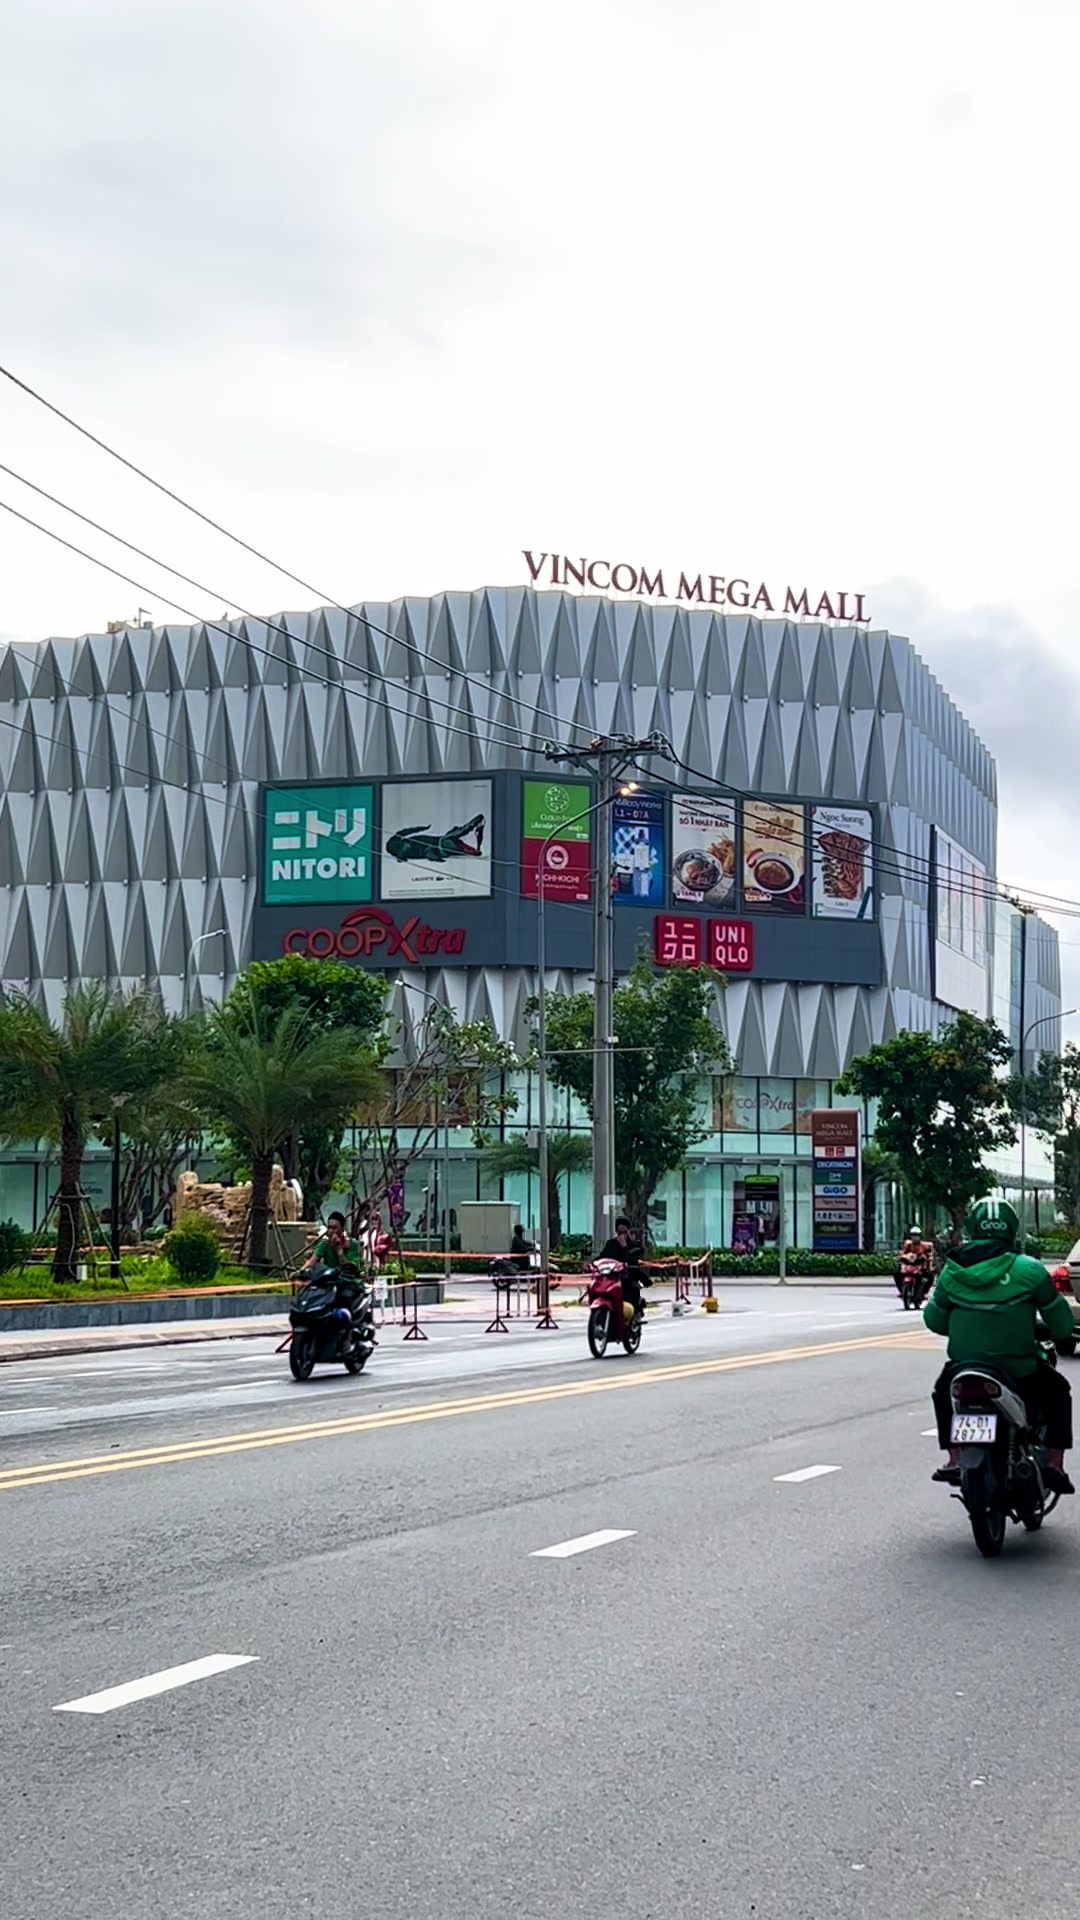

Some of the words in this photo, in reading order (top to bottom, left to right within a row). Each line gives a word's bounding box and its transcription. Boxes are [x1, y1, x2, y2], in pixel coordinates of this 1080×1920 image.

[521, 550, 668, 598] VINCOM
[675, 571, 775, 612] MEGA
[782, 585, 872, 623] MALL
[272, 808, 366, 850] ニトリ
[272, 856, 366, 881] NITORI
[715, 925, 746, 944] UNI
[715, 945, 749, 966] QLO
[980, 1220, 1007, 1231] Grab
